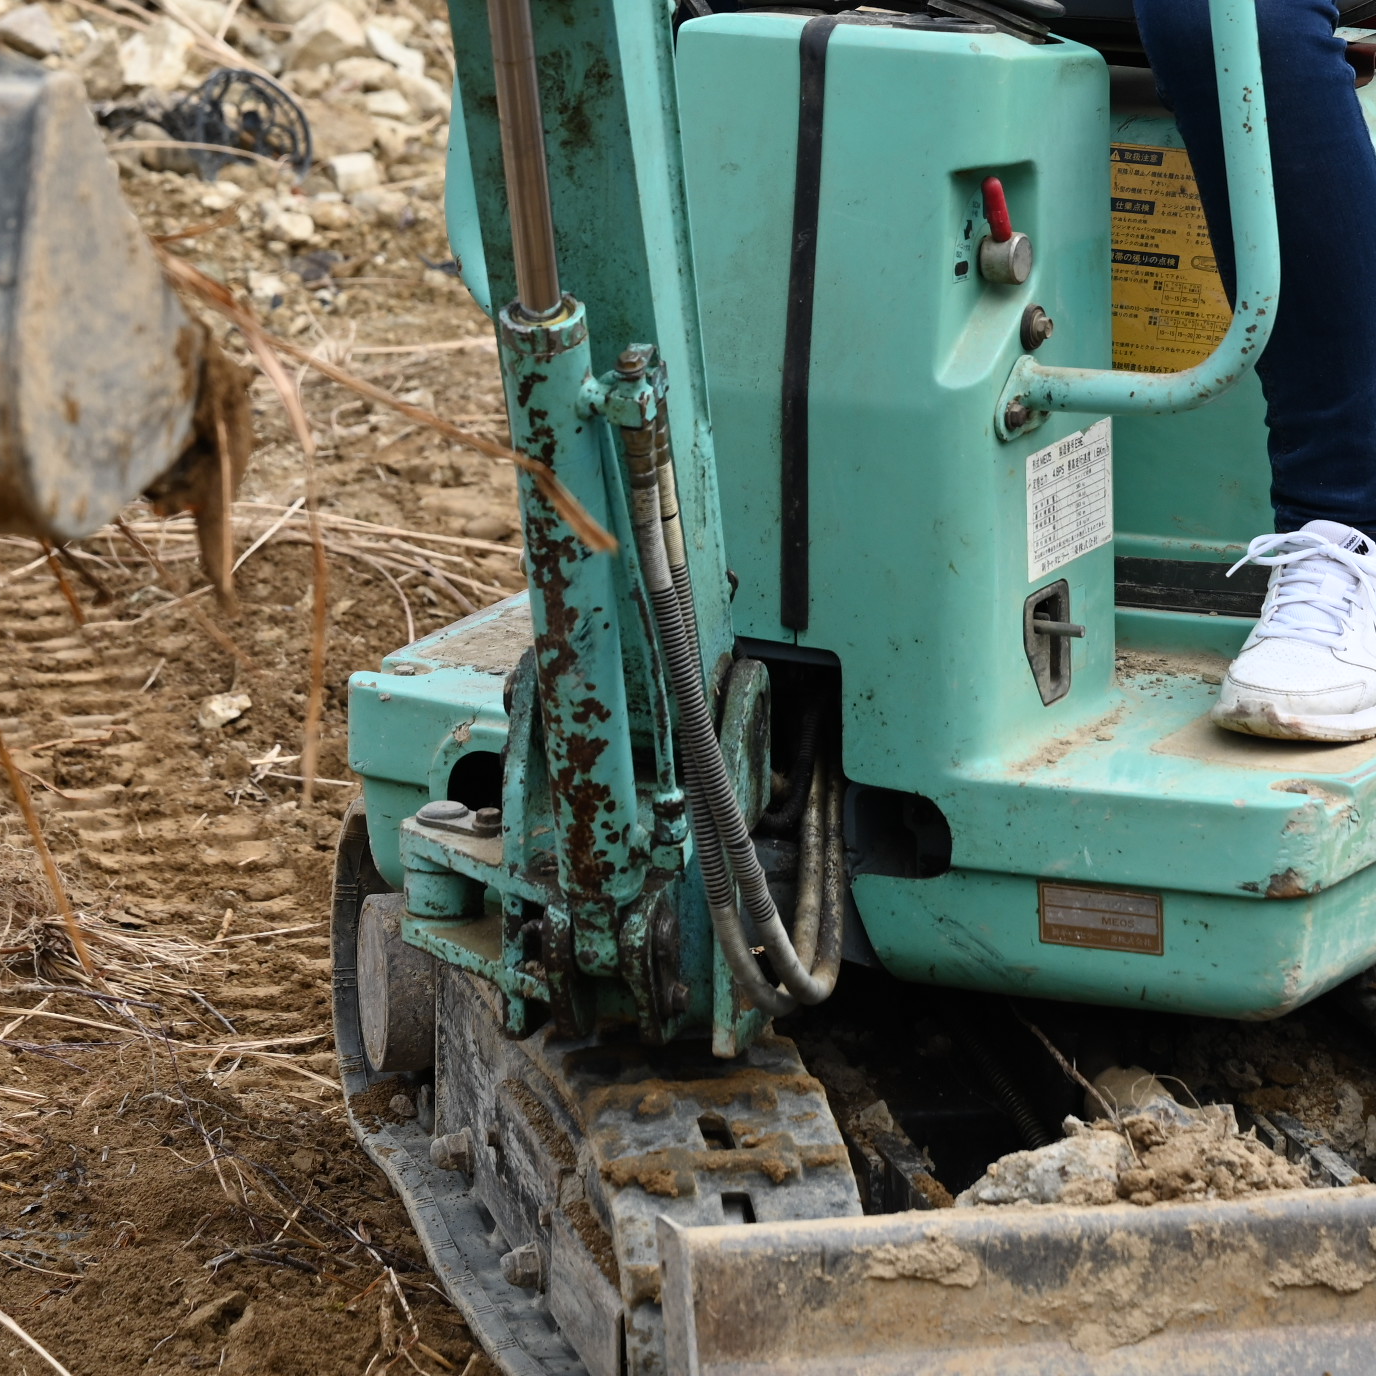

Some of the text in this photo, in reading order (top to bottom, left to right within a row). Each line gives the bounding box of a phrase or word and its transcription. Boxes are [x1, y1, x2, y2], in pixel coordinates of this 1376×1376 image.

[1124, 151, 1158, 162] 取扱注意
[1115, 201, 1150, 212] 仕業点検
